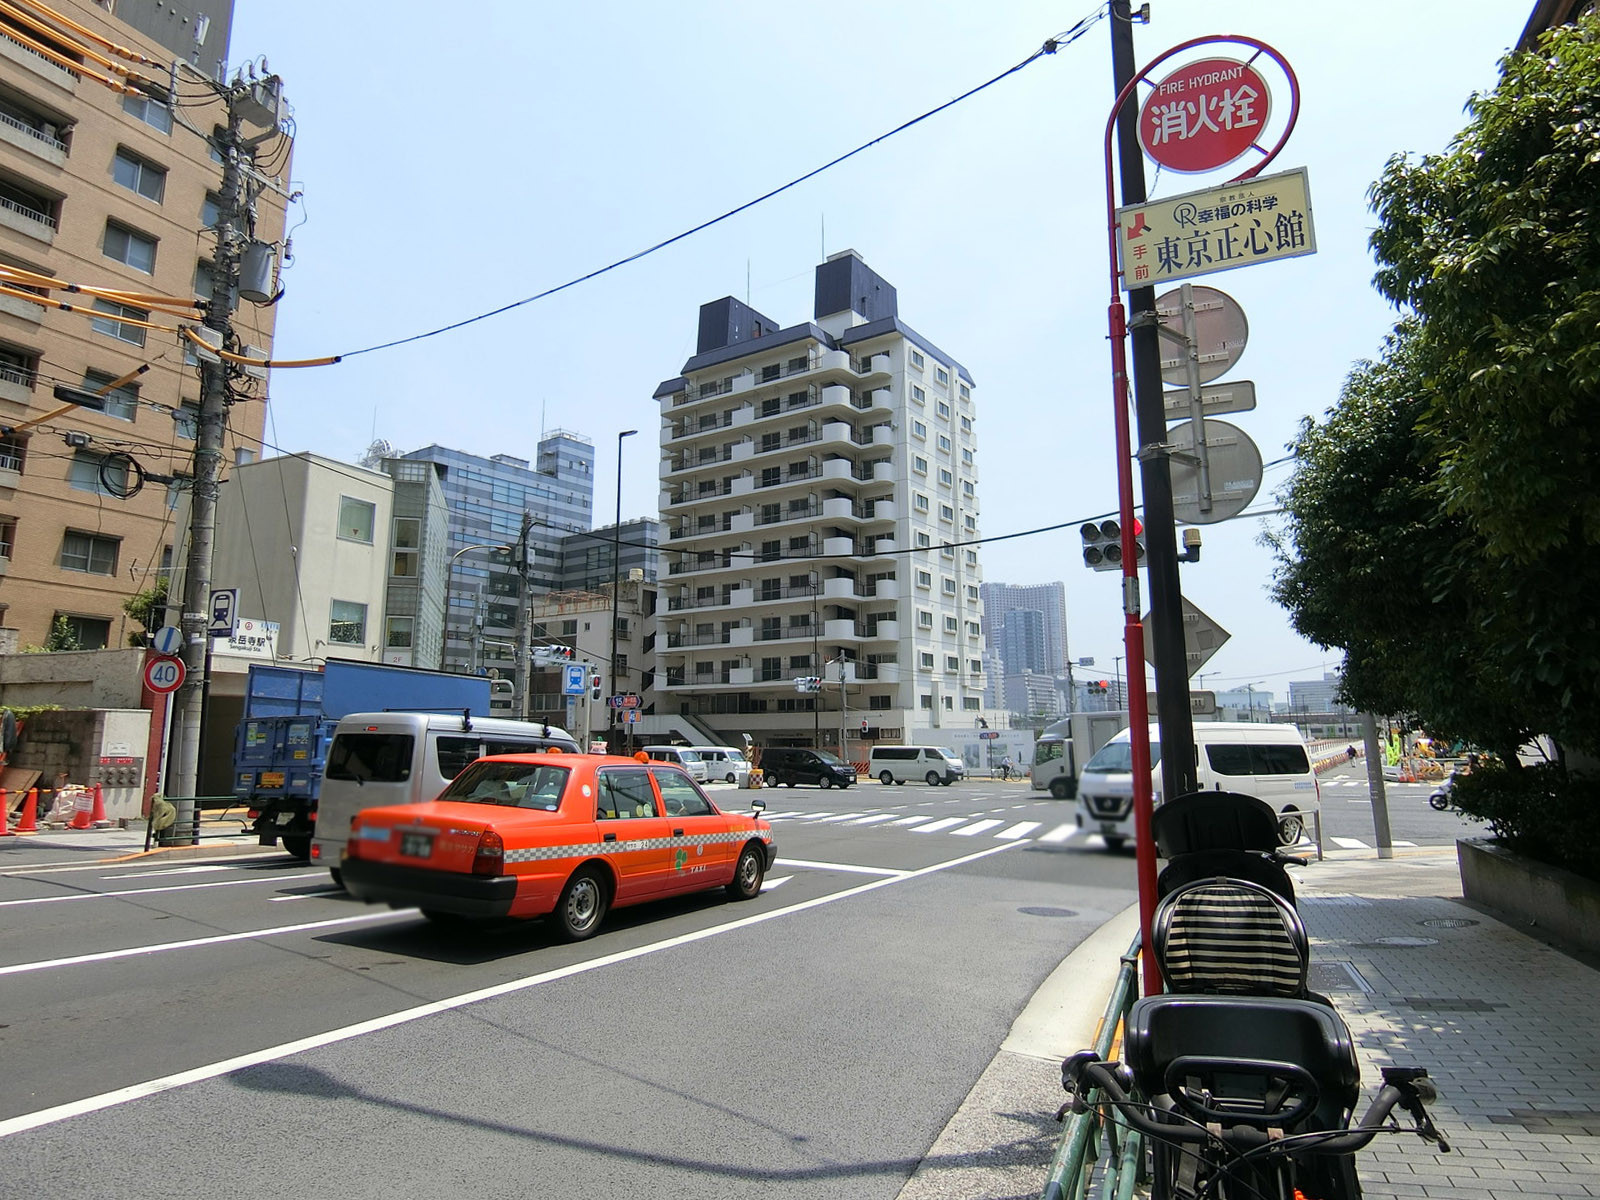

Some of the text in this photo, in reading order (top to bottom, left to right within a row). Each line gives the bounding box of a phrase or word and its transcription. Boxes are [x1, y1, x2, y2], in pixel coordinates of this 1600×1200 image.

[1159, 65, 1245, 97] FIRE HYDRANT
[1150, 84, 1259, 146] 消火栓
[1197, 195, 1279, 223] 幸福の科学
[1153, 209, 1305, 275] 東京正心館
[1133, 243, 1150, 281] 手前
[153, 665, 176, 683] 40
[690, 864, 707, 874] TAXI
